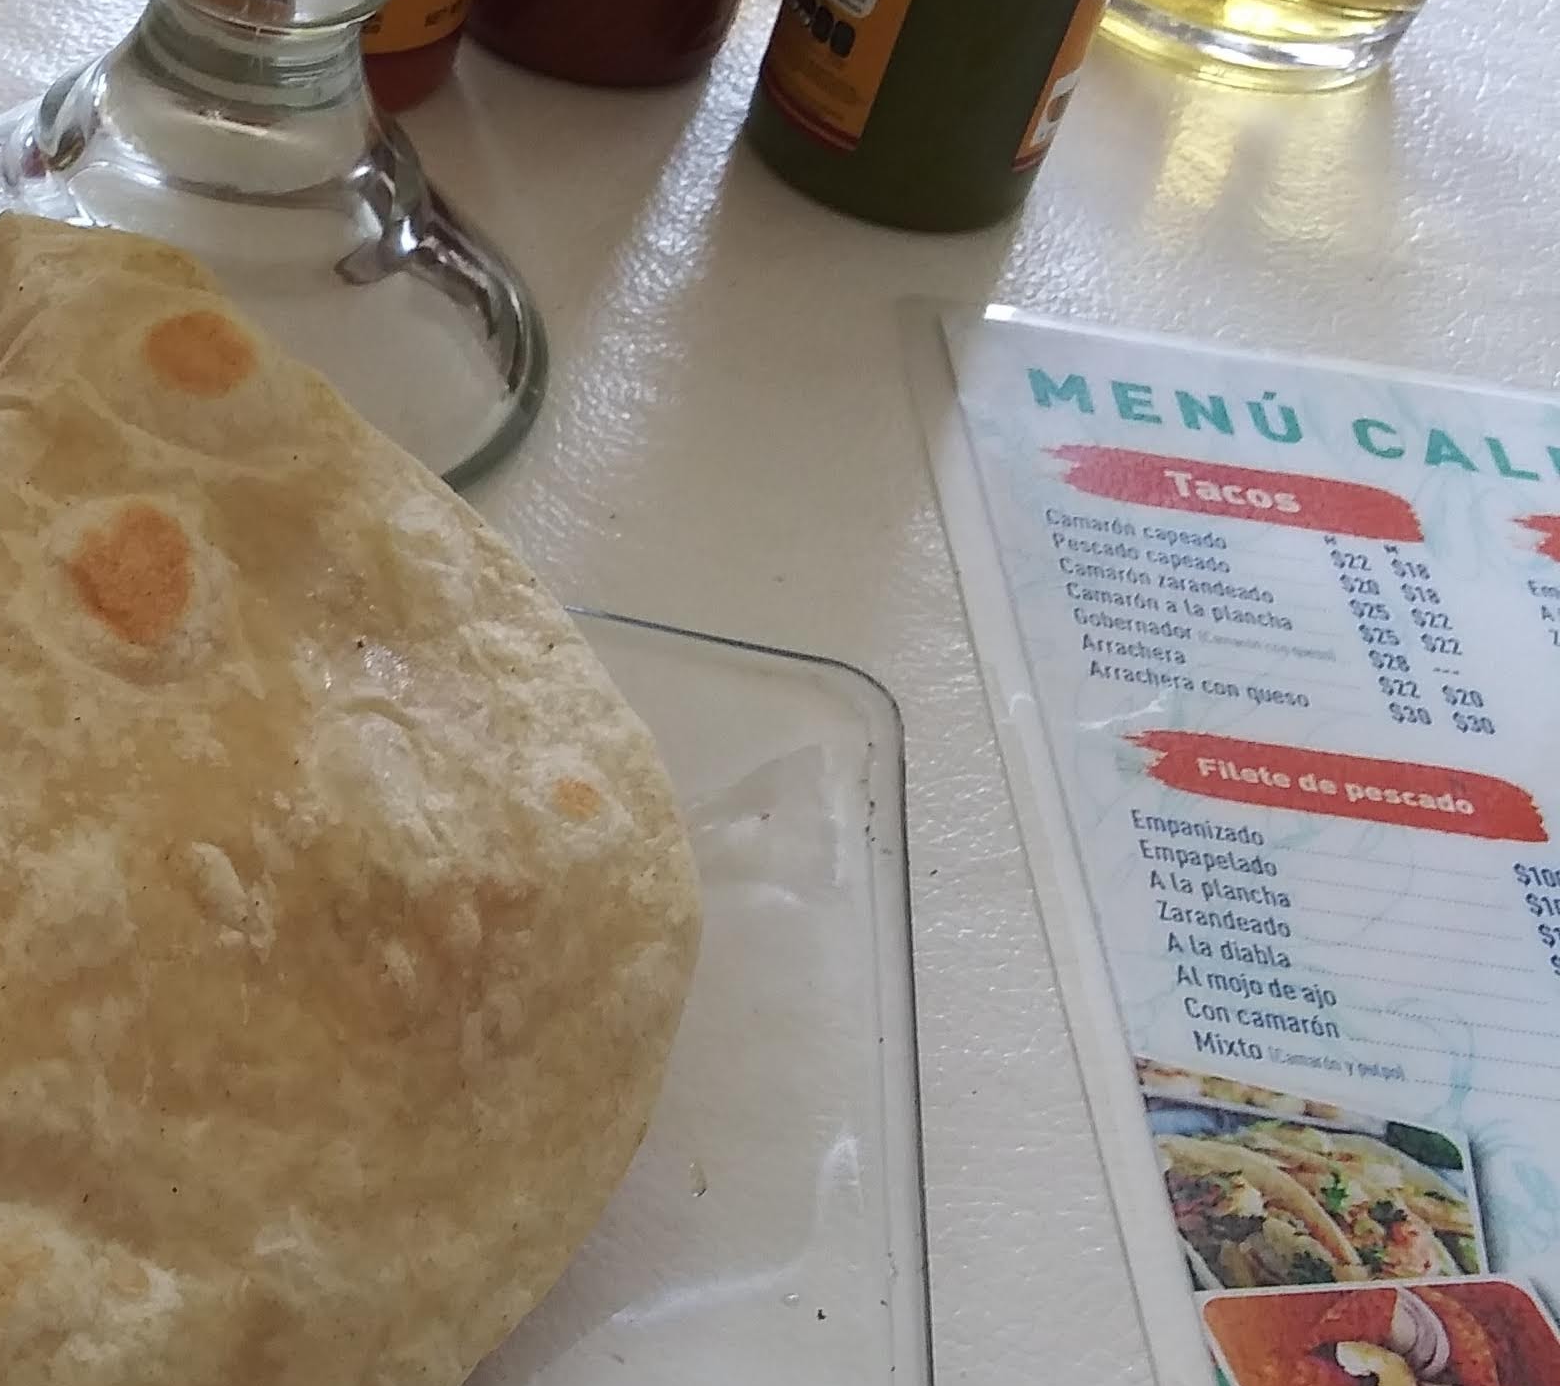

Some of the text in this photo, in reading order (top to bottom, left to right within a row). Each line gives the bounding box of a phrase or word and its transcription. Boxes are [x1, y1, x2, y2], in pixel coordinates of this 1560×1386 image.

[1026, 367, 1303, 444] MENÚ
[1163, 469, 1302, 514] Tacos
[1046, 508, 1136, 537] Camarón
[1142, 525, 1228, 549] capeado
[1330, 549, 1372, 571] $22
[1052, 532, 1140, 561] Pescado
[1146, 549, 1231, 574] capeado
[1059, 556, 1152, 586] Camarón
[1411, 608, 1453, 630] $22
[1066, 581, 1159, 613] Camarón
[1166, 604, 1177, 614] a
[1185, 598, 1204, 617] la
[1211, 604, 1293, 631] plancha
[1421, 633, 1463, 656] $22
[1073, 607, 1193, 640] Gobernador
[1082, 634, 1186, 664] Arrachera
[1378, 676, 1421, 699] $22
[1090, 660, 1194, 690] Arrachera
[1202, 680, 1239, 697] con
[1246, 685, 1310, 708] queso
[1197, 758, 1475, 815] Filete de pescado
[1131, 809, 1265, 846] Empanizado
[1139, 839, 1278, 878] Empapelado
[1150, 870, 1291, 908] A la plancha
[1156, 900, 1291, 938] Zarandeado
[1167, 932, 1291, 969] A la diabla
[1176, 964, 1338, 1010] Al mojo de ajo
[1184, 997, 1340, 1038] Con camarón
[1192, 1030, 1264, 1061] Mixto
